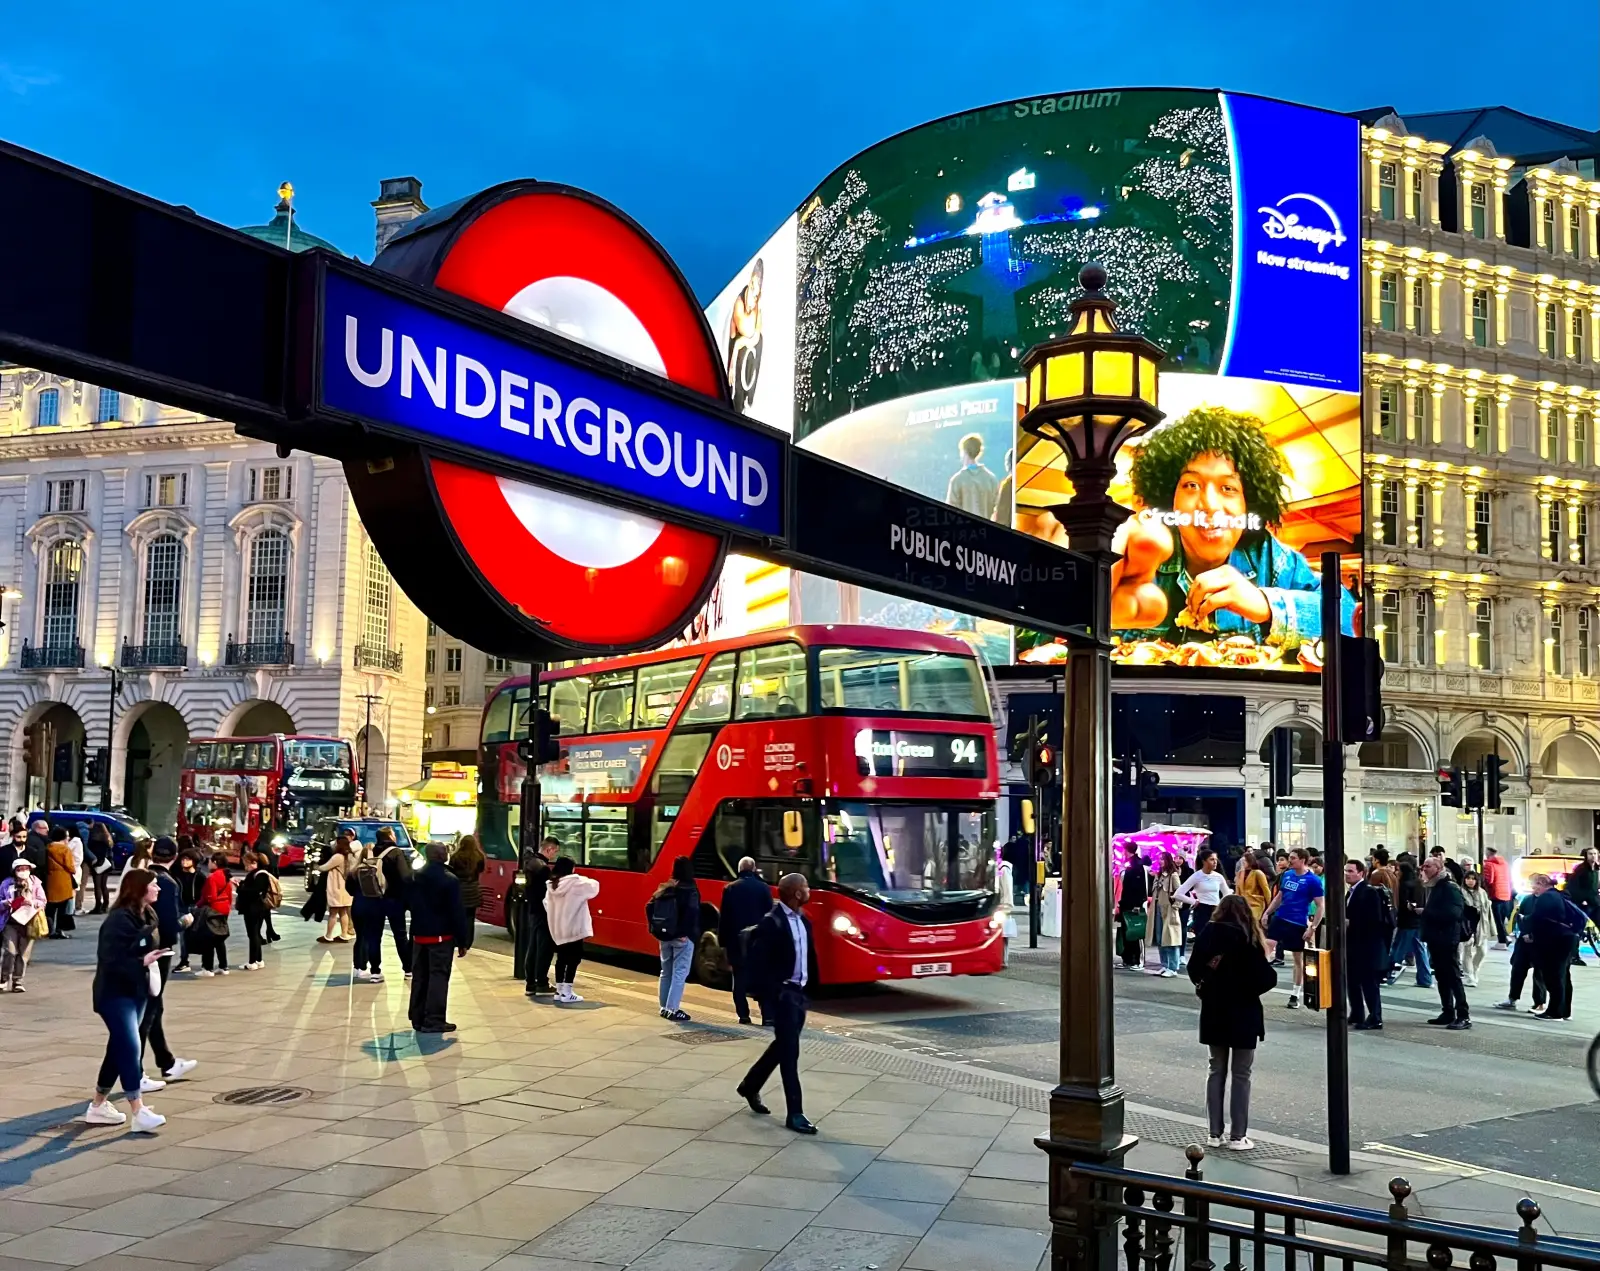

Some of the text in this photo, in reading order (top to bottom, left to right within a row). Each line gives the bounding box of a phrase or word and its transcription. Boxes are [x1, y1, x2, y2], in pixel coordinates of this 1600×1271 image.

[1014, 91, 1122, 119] Stadium
[1257, 206, 1347, 254] Disney+
[1257, 250, 1350, 280] Now streaming
[344, 313, 769, 508] UNDERGROUND
[1138, 507, 1193, 527] Circle
[1247, 512, 1261, 531] it
[890, 523, 951, 567] PUBLIC
[955, 544, 1017, 586] SUBWAY
[604, 759, 627, 768] CAREER
[896, 740, 934, 758] Green
[950, 738, 978, 763] 94
